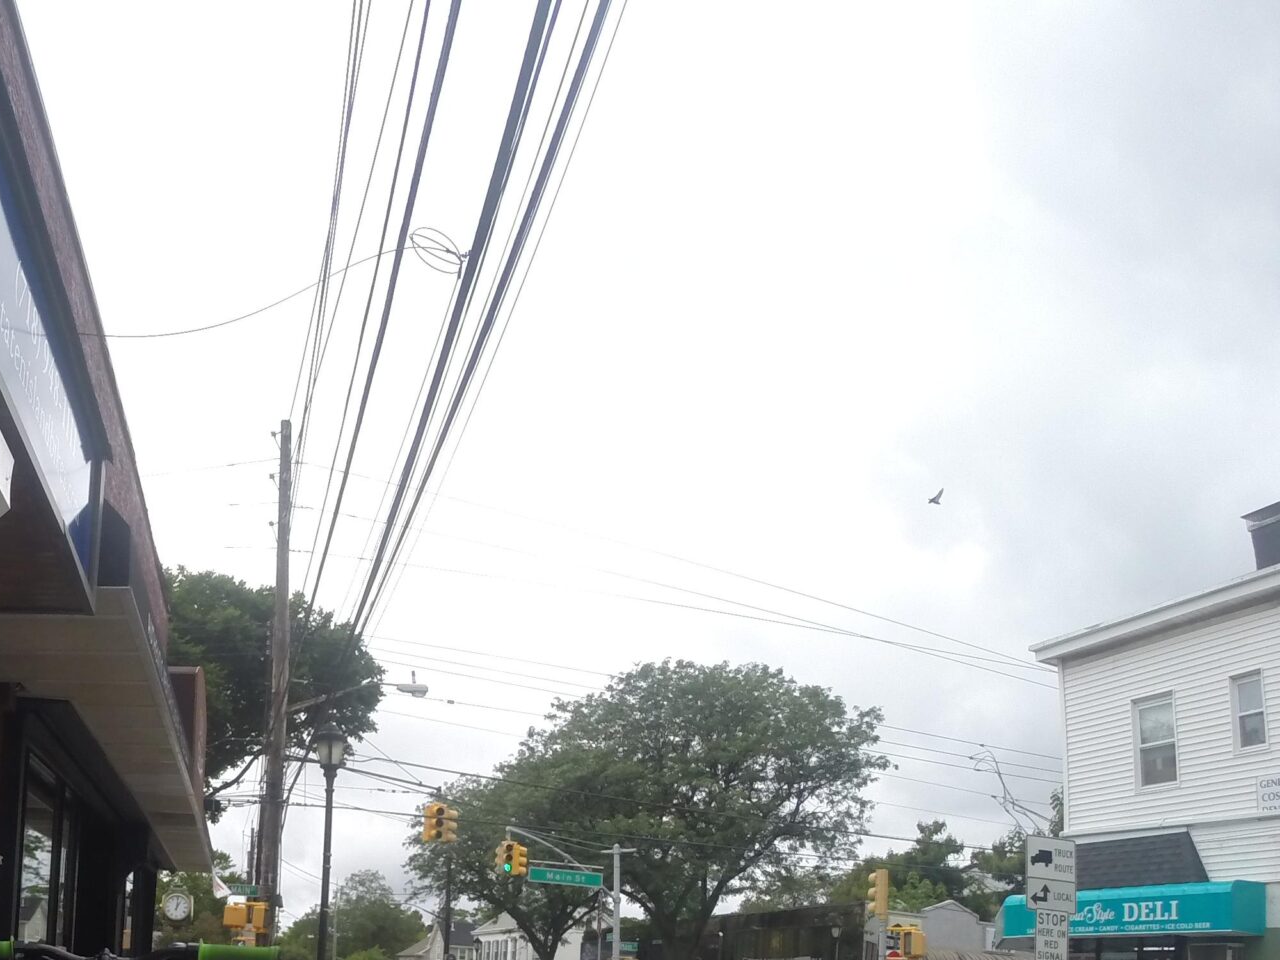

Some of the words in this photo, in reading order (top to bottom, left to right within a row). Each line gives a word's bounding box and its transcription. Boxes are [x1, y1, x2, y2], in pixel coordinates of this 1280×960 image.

[1054, 848, 1073, 858] TRUCK
[1054, 864, 1073, 874] ROUTE
[546, 871, 572, 882] Main
[575, 874, 586, 883] St
[1053, 891, 1073, 902] LOCAL
[1123, 901, 1178, 922] DELI
[1038, 912, 1067, 927] STOP
[1037, 928, 1054, 938] HERE
[1057, 929, 1066, 939] ON
[1044, 940, 1059, 950] RED
